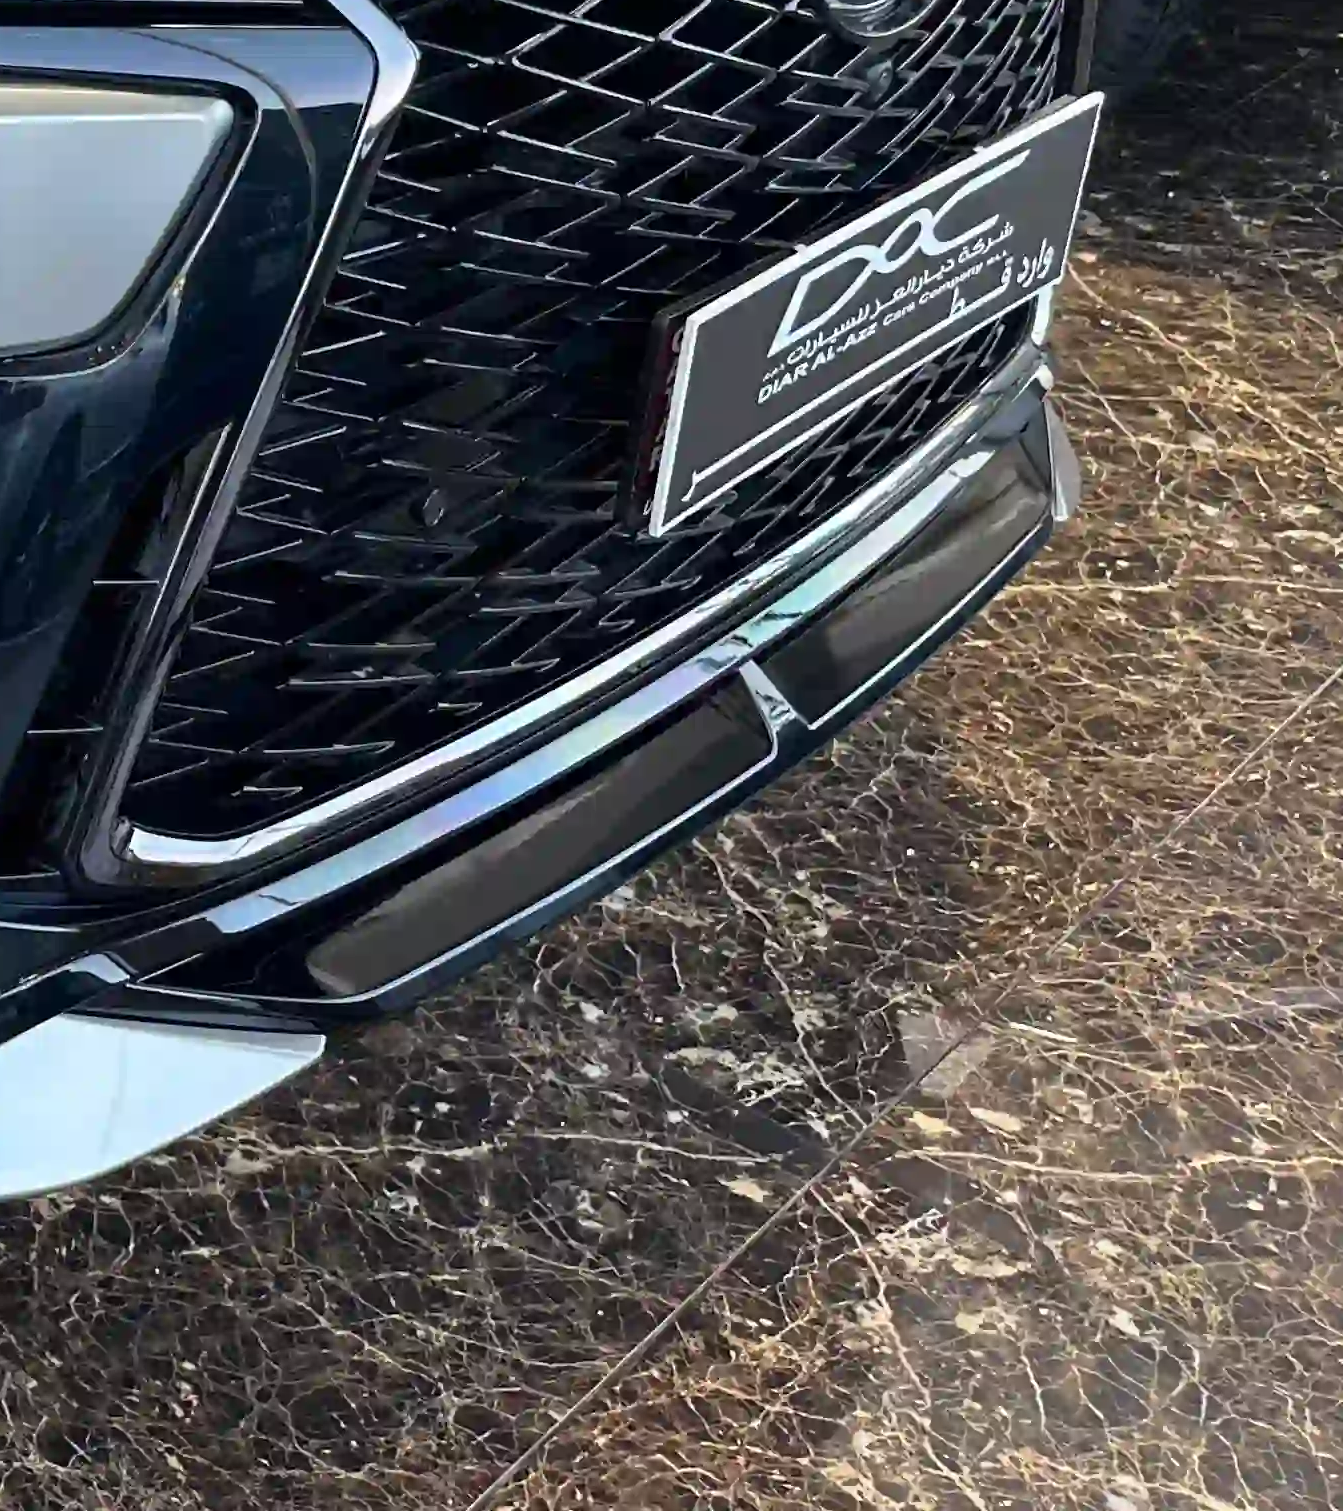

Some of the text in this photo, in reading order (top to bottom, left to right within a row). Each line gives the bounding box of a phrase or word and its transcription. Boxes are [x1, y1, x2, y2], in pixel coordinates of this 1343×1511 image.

[958, 221, 1015, 264] شركة
[1016, 237, 1055, 288] وارد
[757, 362, 809, 405] DIAR
